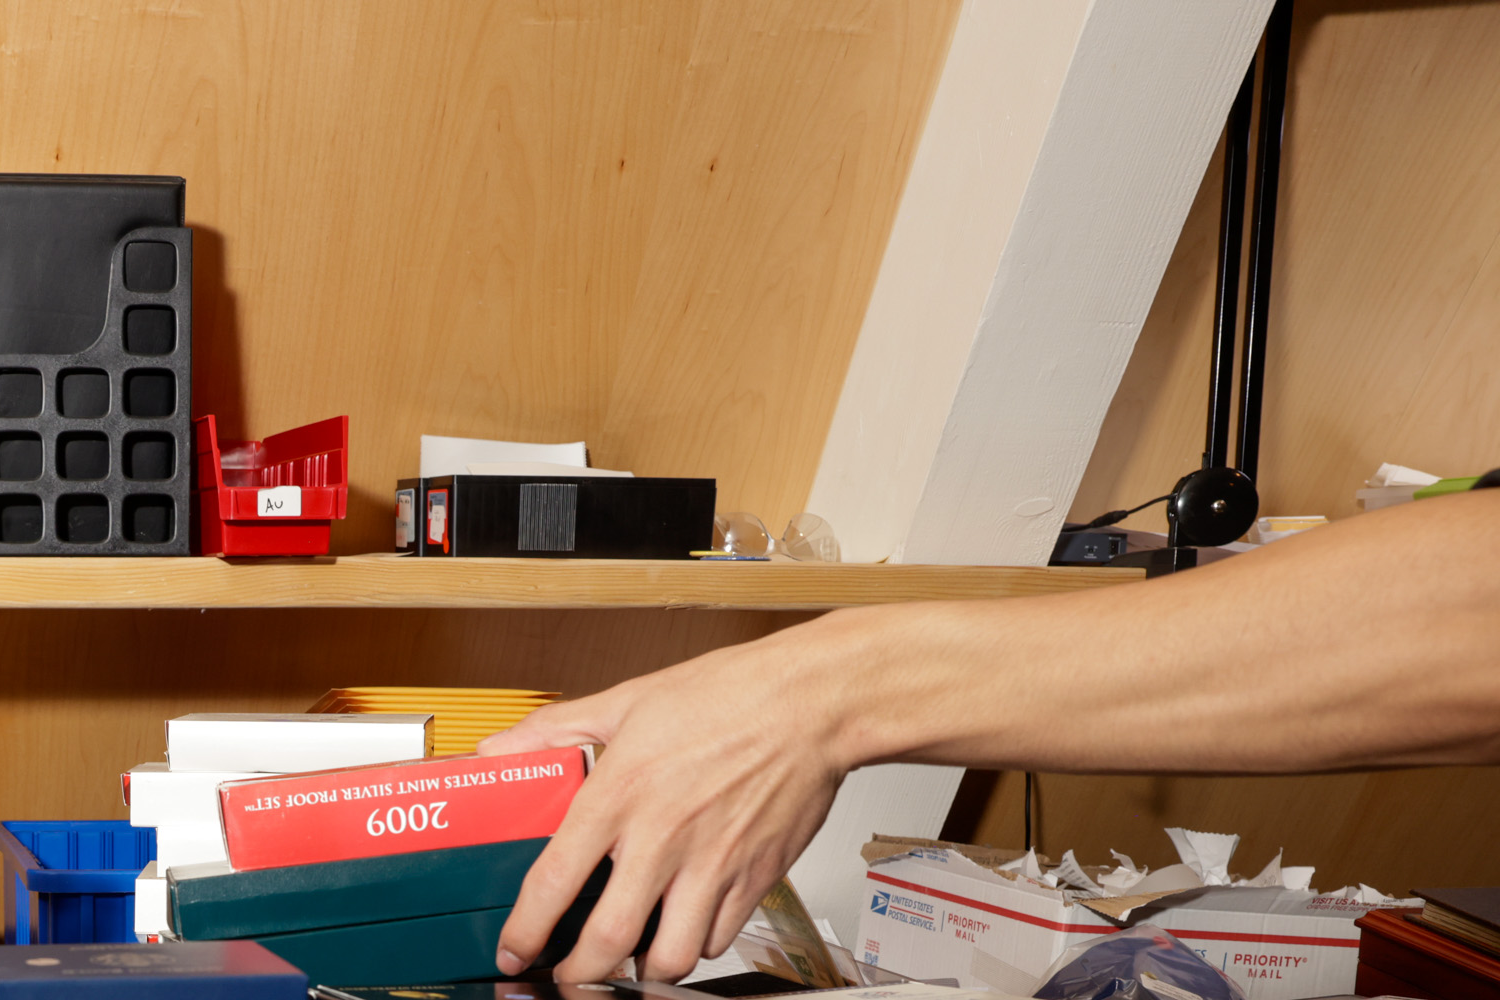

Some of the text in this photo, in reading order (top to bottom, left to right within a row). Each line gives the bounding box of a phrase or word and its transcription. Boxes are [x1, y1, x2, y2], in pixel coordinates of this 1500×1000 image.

[443, 770, 497, 789] STATES
[500, 764, 564, 783] UNITED
[342, 782, 393, 801] SILVER
[397, 777, 440, 795] MINT
[285, 787, 338, 807] PROOF
[366, 801, 449, 837] 2009
[891, 894, 934, 914] UNITED STATES
[1312, 897, 1335, 905] VISIT
[1335, 898, 1349, 906] US
[888, 909, 909, 923] POSTAL
[955, 929, 976, 943] MAIL
[1247, 968, 1283, 979] MAIL
